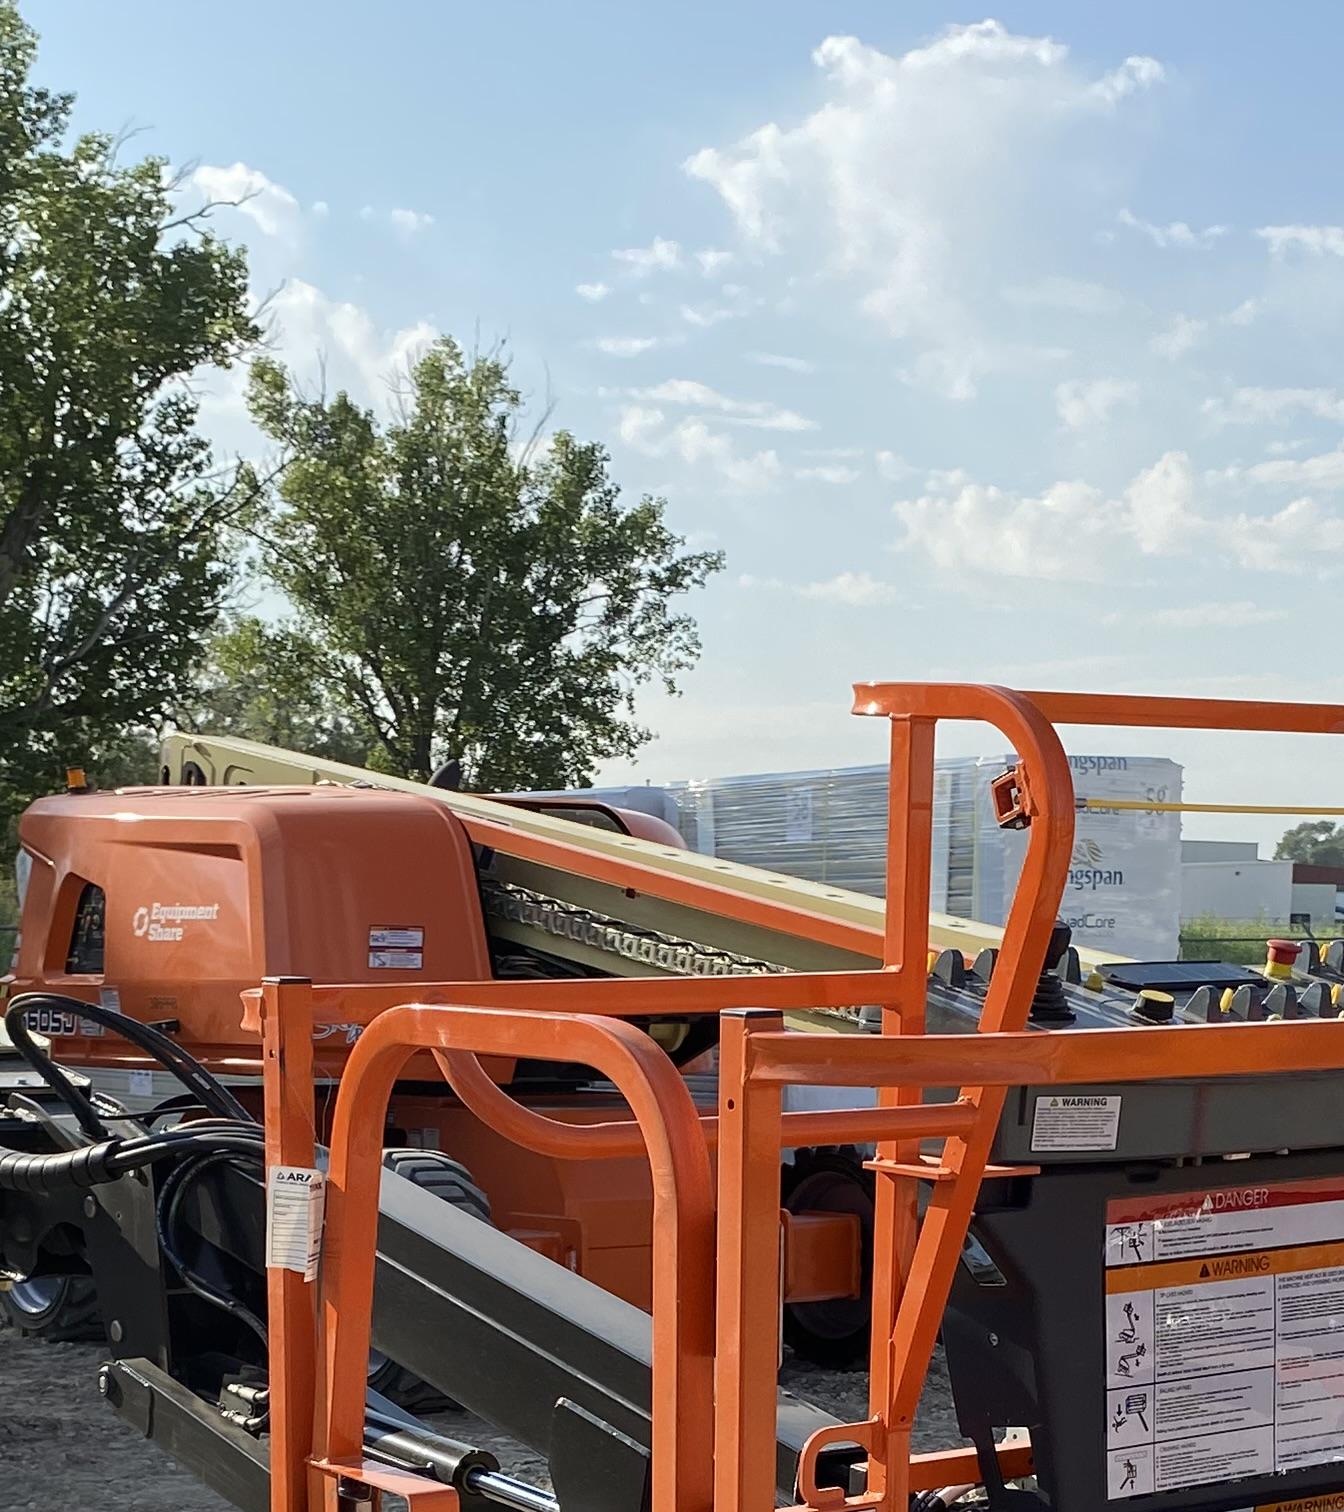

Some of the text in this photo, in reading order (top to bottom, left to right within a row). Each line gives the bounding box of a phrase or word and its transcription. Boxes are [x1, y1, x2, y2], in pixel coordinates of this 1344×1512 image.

[1067, 869, 1123, 890] ngspan
[151, 902, 219, 924] Equipment
[148, 923, 183, 941] Share
[1061, 1097, 1108, 1107] WARNING
[1216, 1187, 1270, 1209] DANGER
[1212, 1255, 1270, 1276] WARNING
